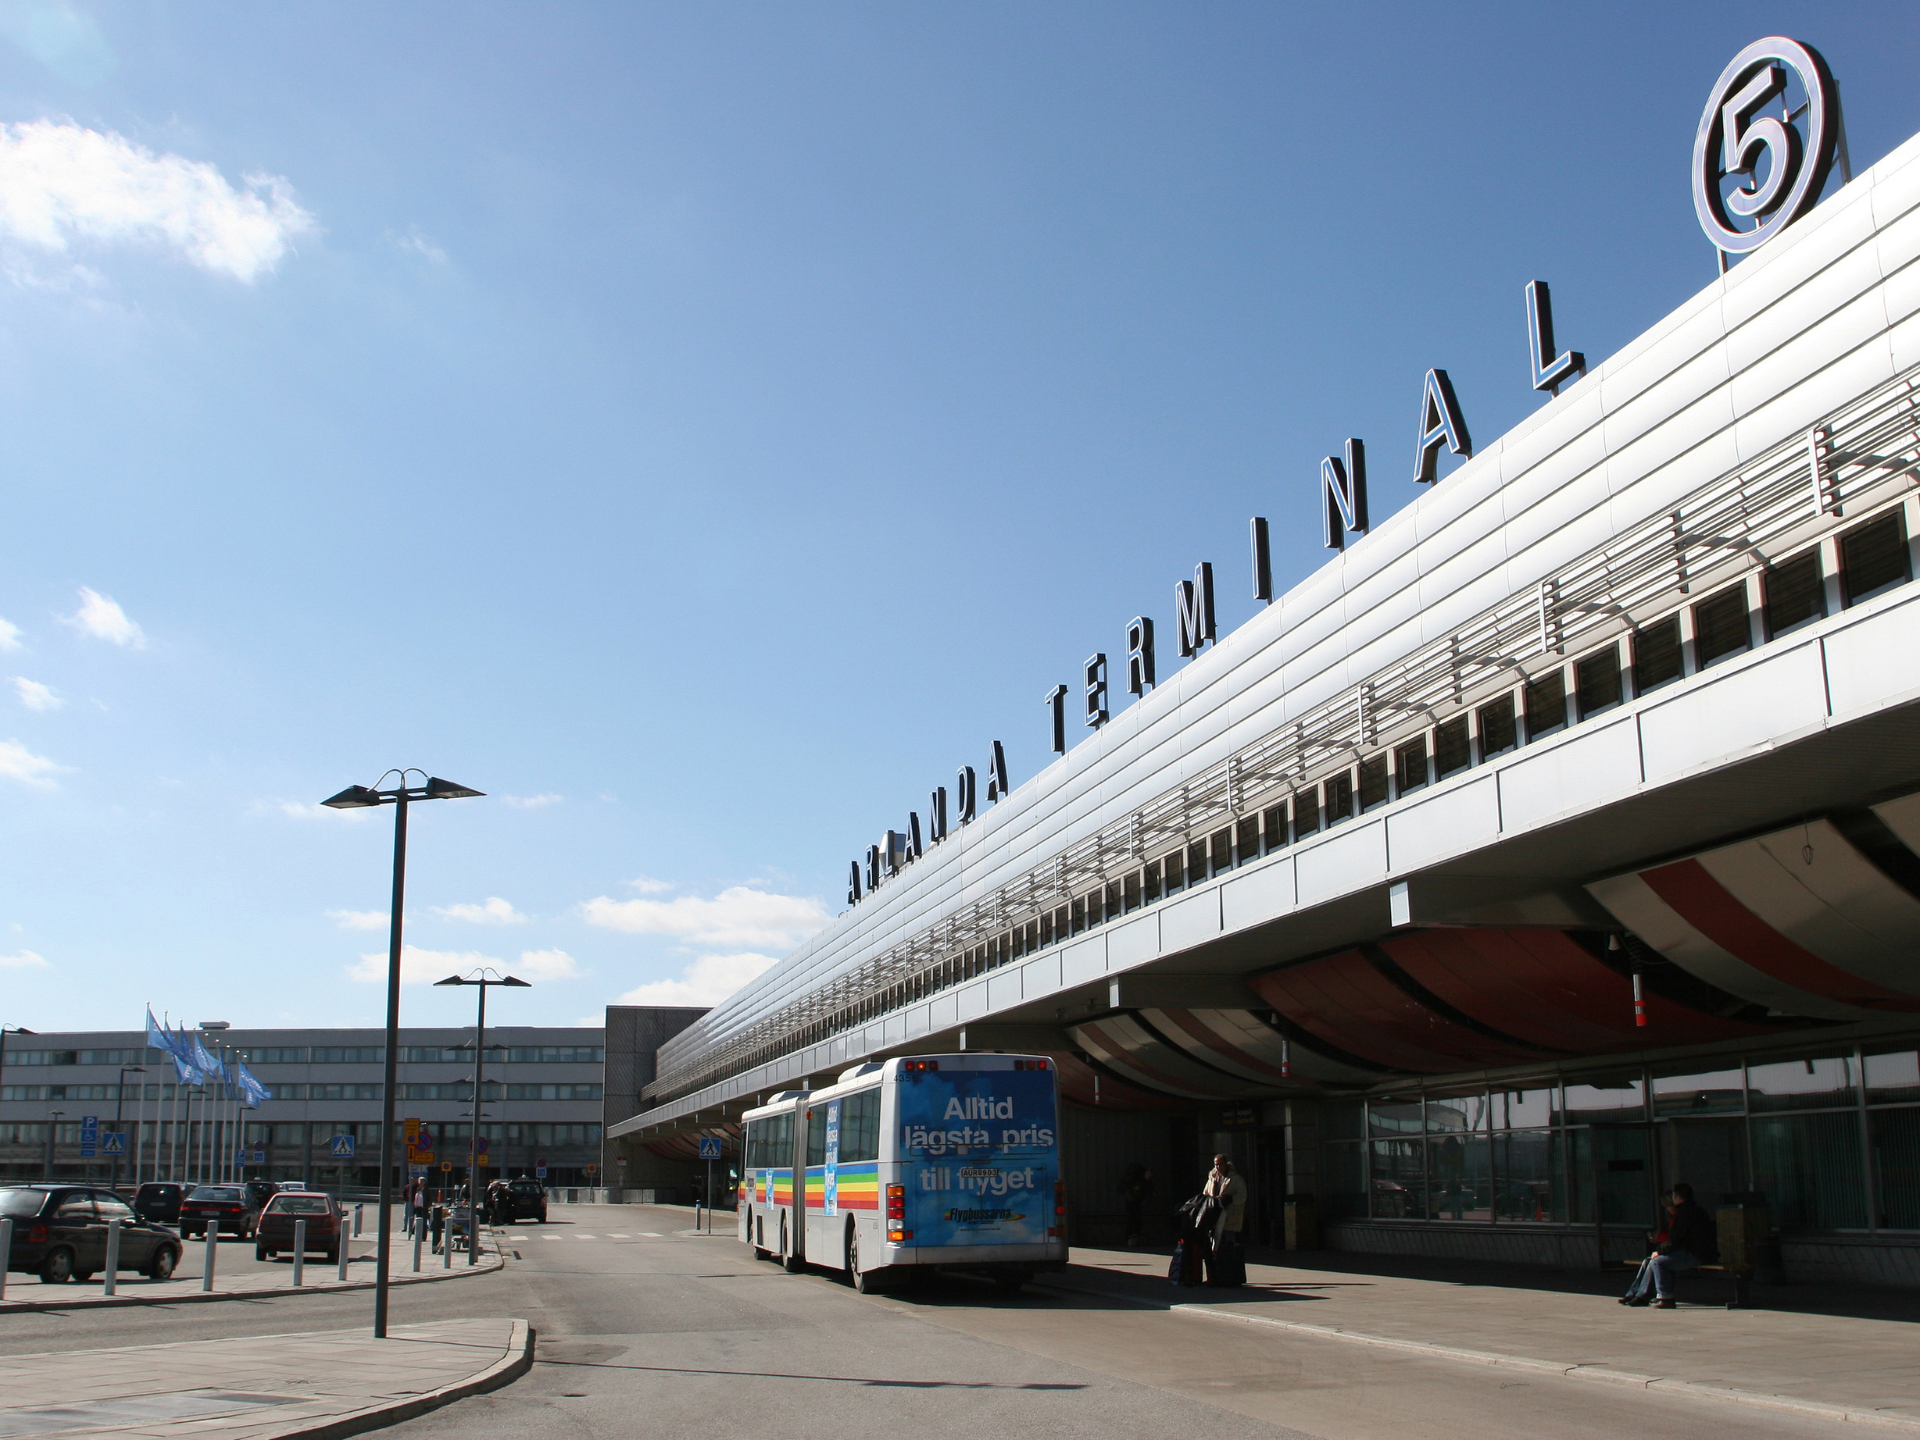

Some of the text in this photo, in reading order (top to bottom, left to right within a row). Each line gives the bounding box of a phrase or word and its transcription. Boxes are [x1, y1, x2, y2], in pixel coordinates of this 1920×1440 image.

[847, 65, 1803, 904] ARLANDA TERMINAL 5
[893, 1074, 918, 1083] 4356
[944, 1096, 1014, 1120] Alltid
[86, 1117, 95, 1128] P
[904, 1124, 1054, 1155] lägsta pris
[920, 1167, 1035, 1195] till flyget
[982, 1168, 997, 1176] 903
[950, 1207, 1012, 1223] Flygbussarna
